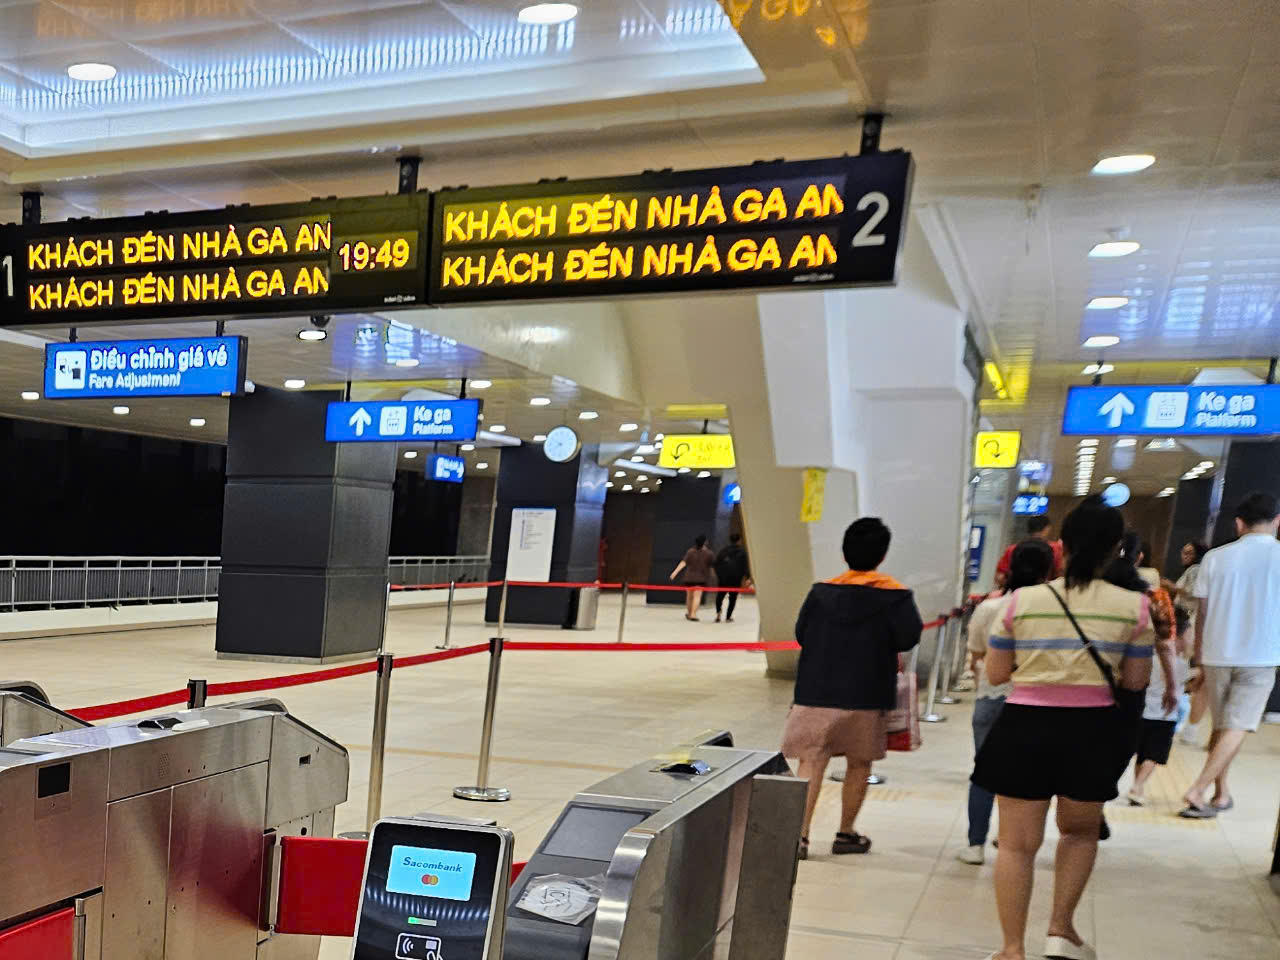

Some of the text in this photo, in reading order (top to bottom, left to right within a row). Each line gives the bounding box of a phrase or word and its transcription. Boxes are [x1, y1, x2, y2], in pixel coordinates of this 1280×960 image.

[445, 201, 557, 243] KHÁCH
[647, 185, 727, 229] NHÀ
[732, 187, 788, 222] GA
[851, 191, 890, 247] 2
[28, 236, 114, 271] KHÁCH
[183, 224, 243, 260] NHÀ
[247, 225, 289, 255] GA
[295, 222, 332, 253] AN
[338, 238, 410, 272] 19:49
[443, 247, 555, 287] KHÁCH
[642, 234, 722, 278] NHÀ
[726, 237, 783, 272] GA
[2, 255, 14, 297] 1
[29, 276, 114, 310] KHÁCH
[183, 266, 242, 302] NHÀ
[246, 269, 286, 298] GA
[178, 345, 204, 372] giá
[207, 344, 228, 368] vé
[89, 371, 182, 392] Fare Adjustment
[413, 405, 452, 425] Ke ga
[1198, 391, 1256, 415] Ke ga
[412, 423, 454, 436] Platform
[1196, 411, 1257, 429] Platform
[402, 856, 463, 873] Sacombank
